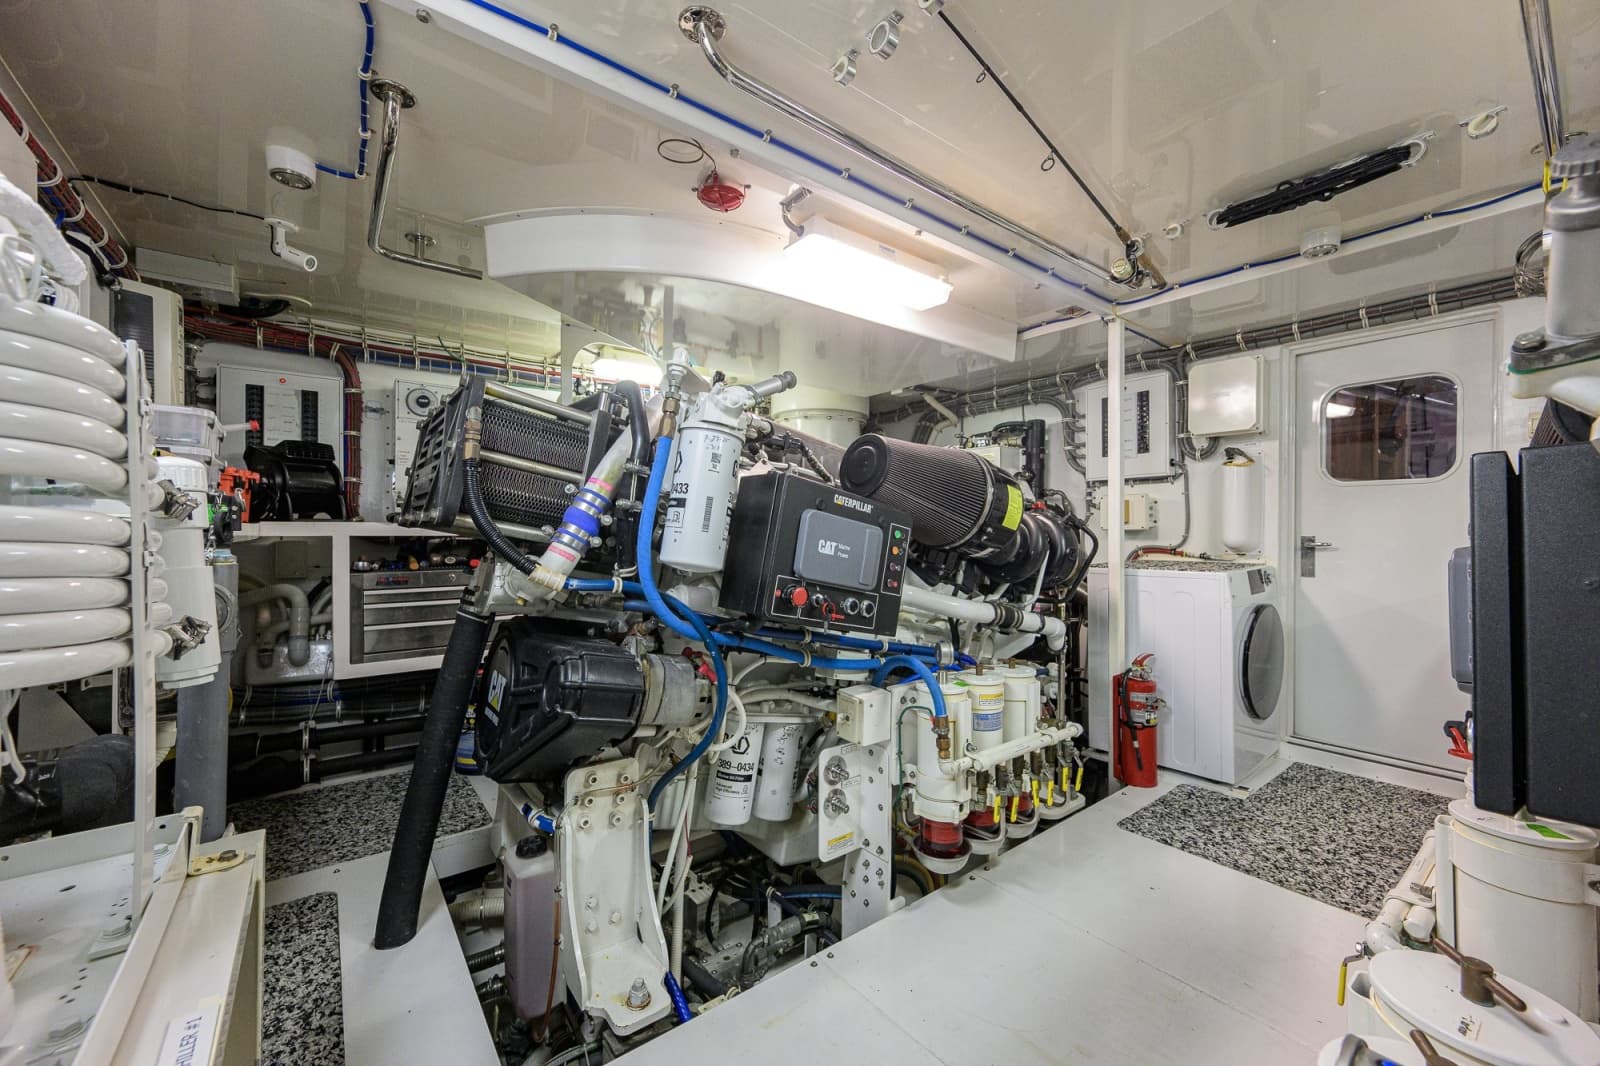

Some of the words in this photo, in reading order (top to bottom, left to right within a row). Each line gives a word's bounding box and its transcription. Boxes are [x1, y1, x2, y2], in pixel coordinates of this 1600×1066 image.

[834, 493, 872, 514] CATERPILLAR
[818, 539, 839, 556] CAT
[487, 669, 507, 713] CAT
